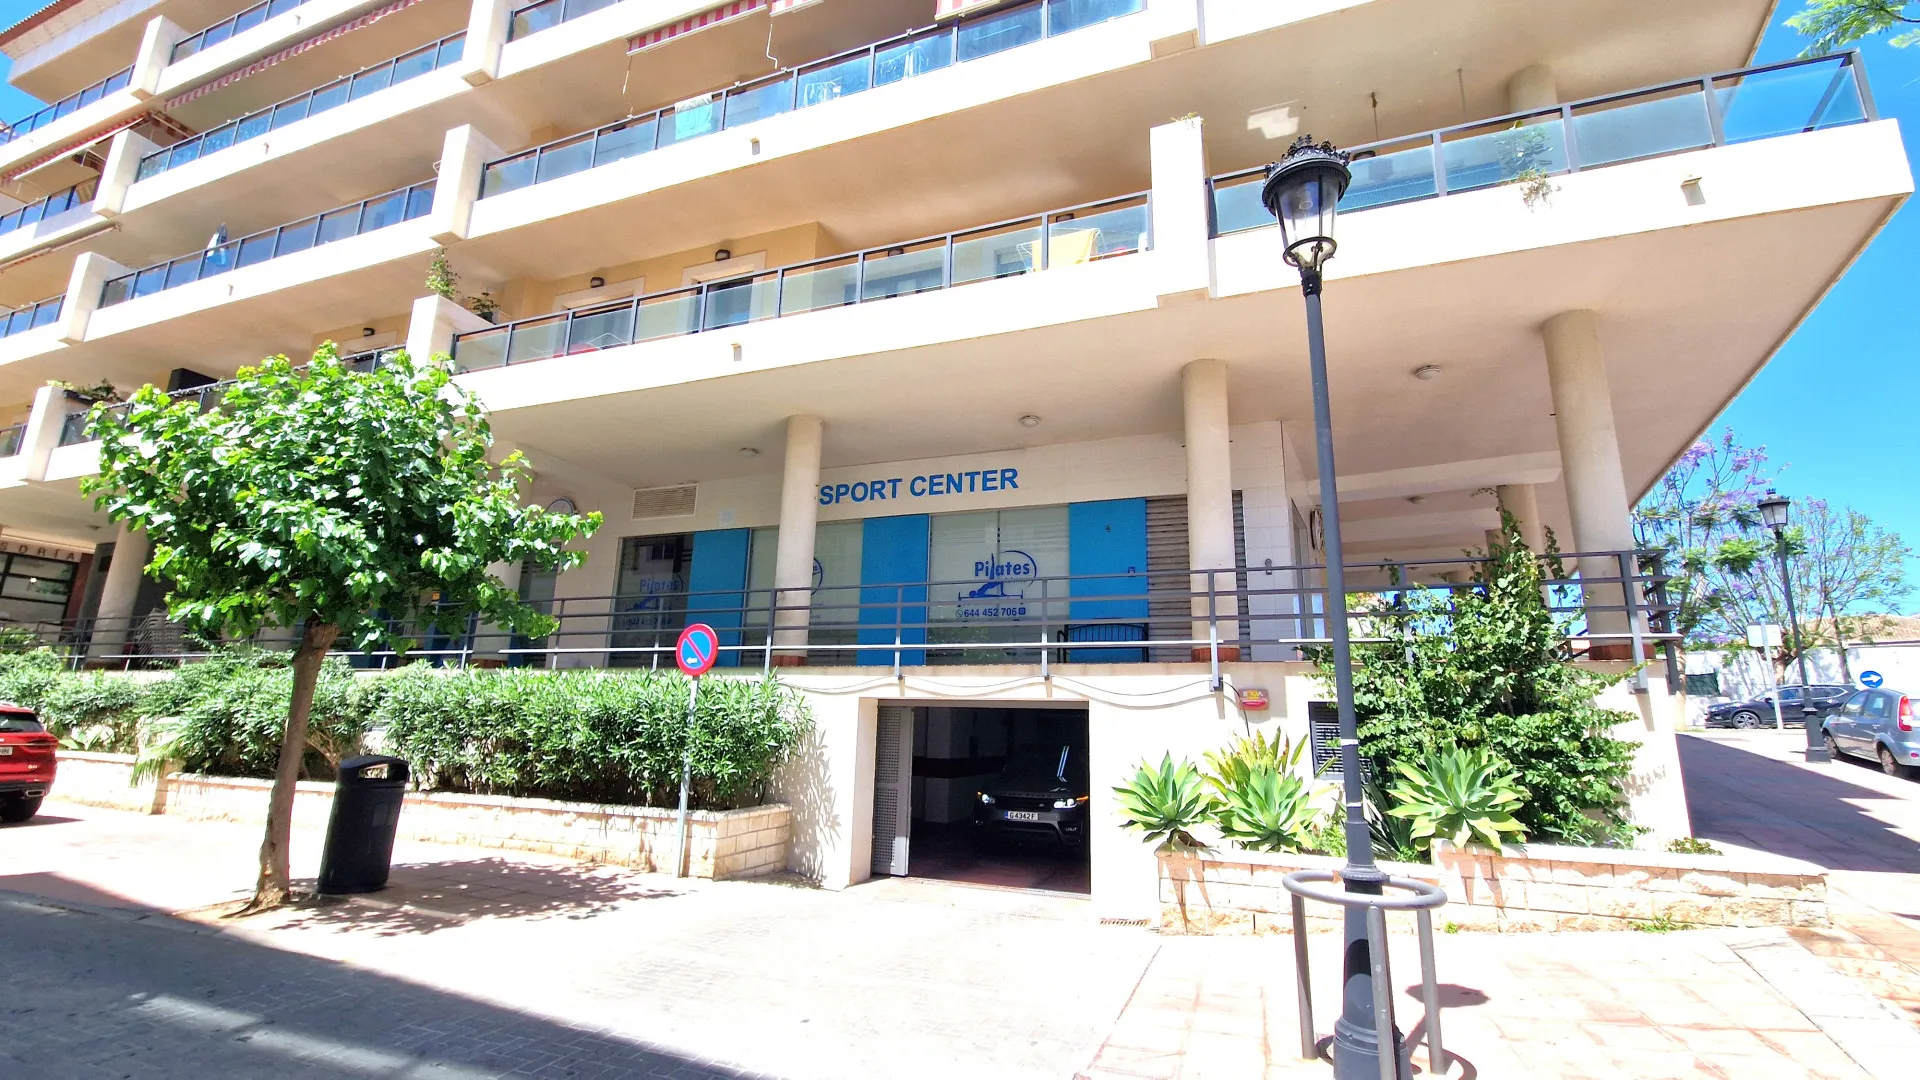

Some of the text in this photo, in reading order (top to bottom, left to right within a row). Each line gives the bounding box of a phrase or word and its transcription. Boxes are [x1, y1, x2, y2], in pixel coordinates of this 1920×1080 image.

[819, 468, 1019, 505] SPORT CENTER
[974, 553, 1030, 579] Pilates
[963, 606, 1017, 618] 644 452 706
